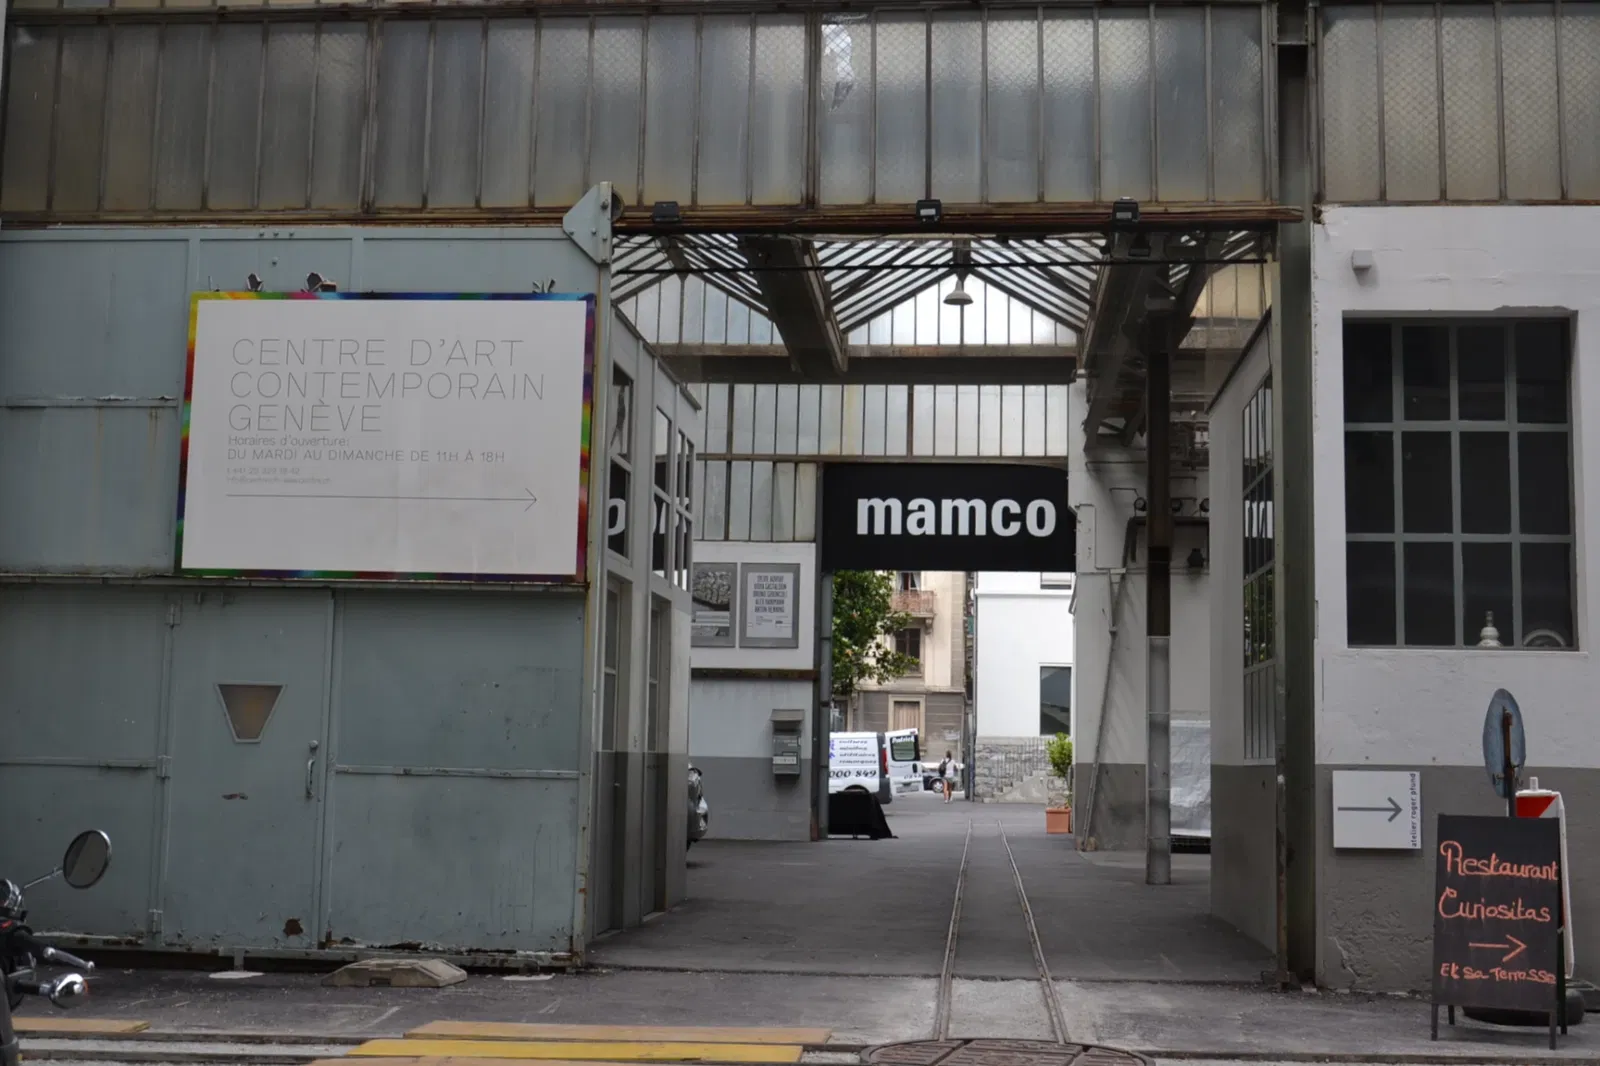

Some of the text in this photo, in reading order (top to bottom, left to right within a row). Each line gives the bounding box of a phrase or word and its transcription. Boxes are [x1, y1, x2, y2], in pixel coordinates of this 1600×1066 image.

[232, 338, 524, 367] CENTRE D'ART
[230, 371, 545, 400] CONTEMPORAIN
[228, 398, 382, 432] GENÈVE
[228, 435, 276, 446] Horaires
[227, 448, 505, 463] DU MARDI AU DIMANCHE DE 11H À 18H
[856, 497, 1057, 538] mamco
[855, 769, 877, 778] 849
[1410, 796, 1418, 820] roger
[1440, 840, 1559, 881] Restaurant
[1438, 886, 1551, 923] Curiositas
[1440, 962, 1460, 980] Et
